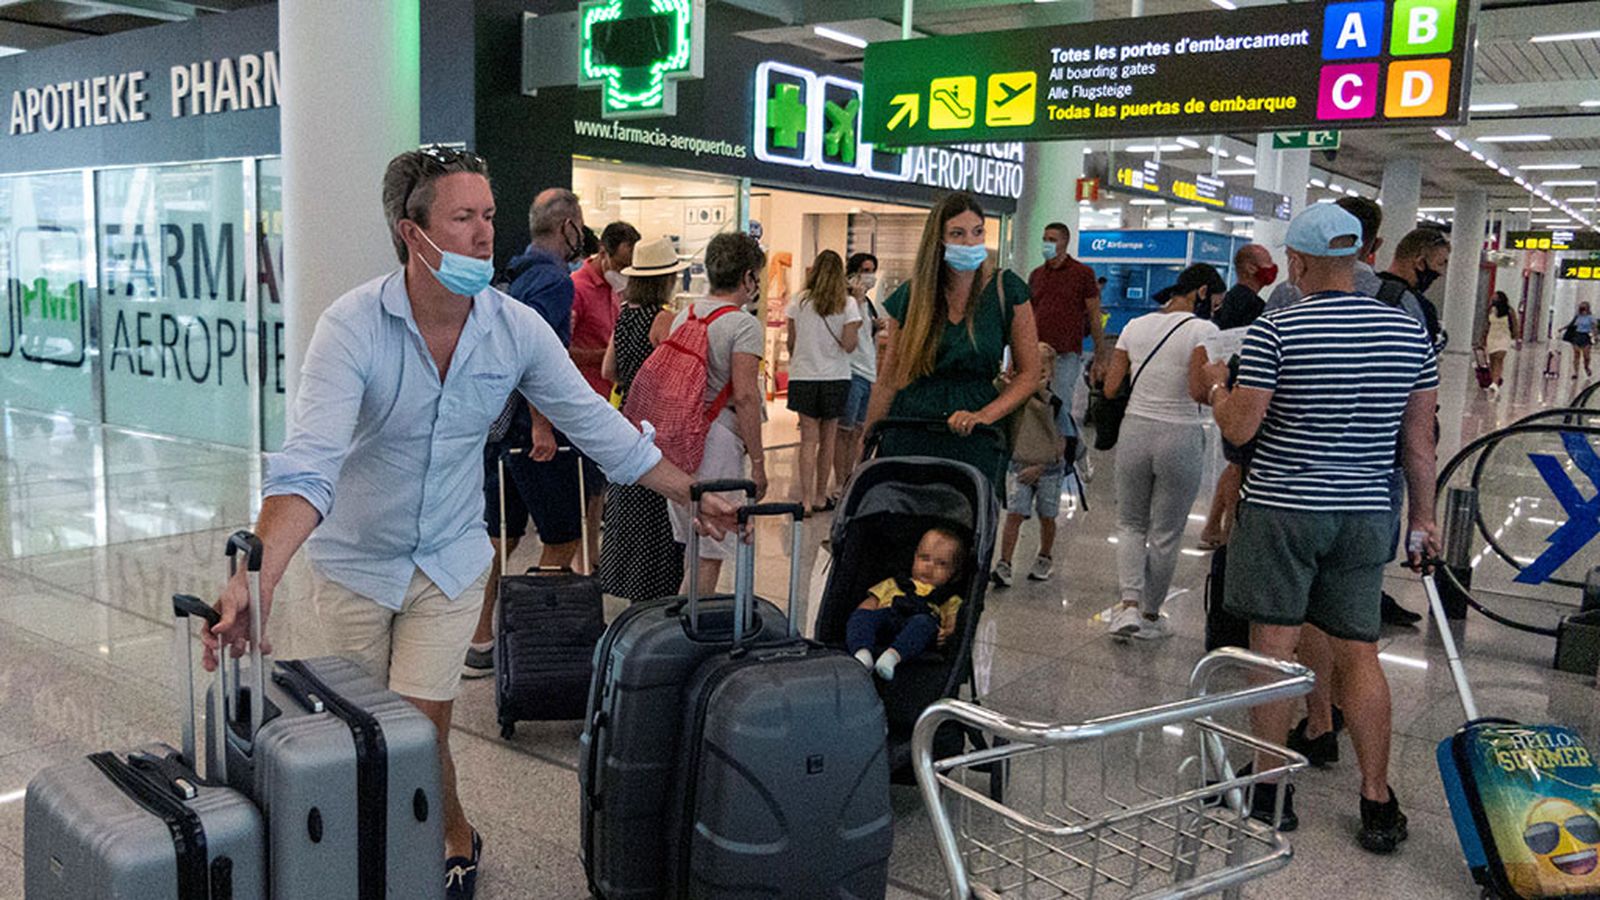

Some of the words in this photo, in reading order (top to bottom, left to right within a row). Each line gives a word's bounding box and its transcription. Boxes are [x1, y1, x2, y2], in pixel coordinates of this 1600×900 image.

[1050, 48, 1091, 64] Totes
[1094, 44, 1117, 60] les
[1119, 41, 1171, 62] portes
[1174, 28, 1309, 54] d'embarcament
[1336, 12, 1368, 50] A
[1407, 6, 1439, 45] B
[1049, 67, 1064, 81] All
[1066, 64, 1118, 80] boarding
[1121, 62, 1156, 79] gates
[1331, 73, 1363, 110] C
[1400, 70, 1434, 107] D
[9, 70, 147, 136] APOTHEKE
[1047, 87, 1070, 100] Alle
[1071, 83, 1133, 101] Flugsteige
[1047, 104, 1091, 121] Todas
[1094, 103, 1117, 118] las
[1119, 100, 1180, 120] puertas
[1184, 97, 1206, 114] de
[1209, 95, 1297, 113] embarque
[573, 119, 747, 158] www.farmacia-aeropuerto.es
[912, 145, 1024, 199] AEROPUERTO
[105, 222, 283, 304] FARMA
[1497, 746, 1593, 772] SUMMER
[1510, 732, 1572, 750] HELLO
